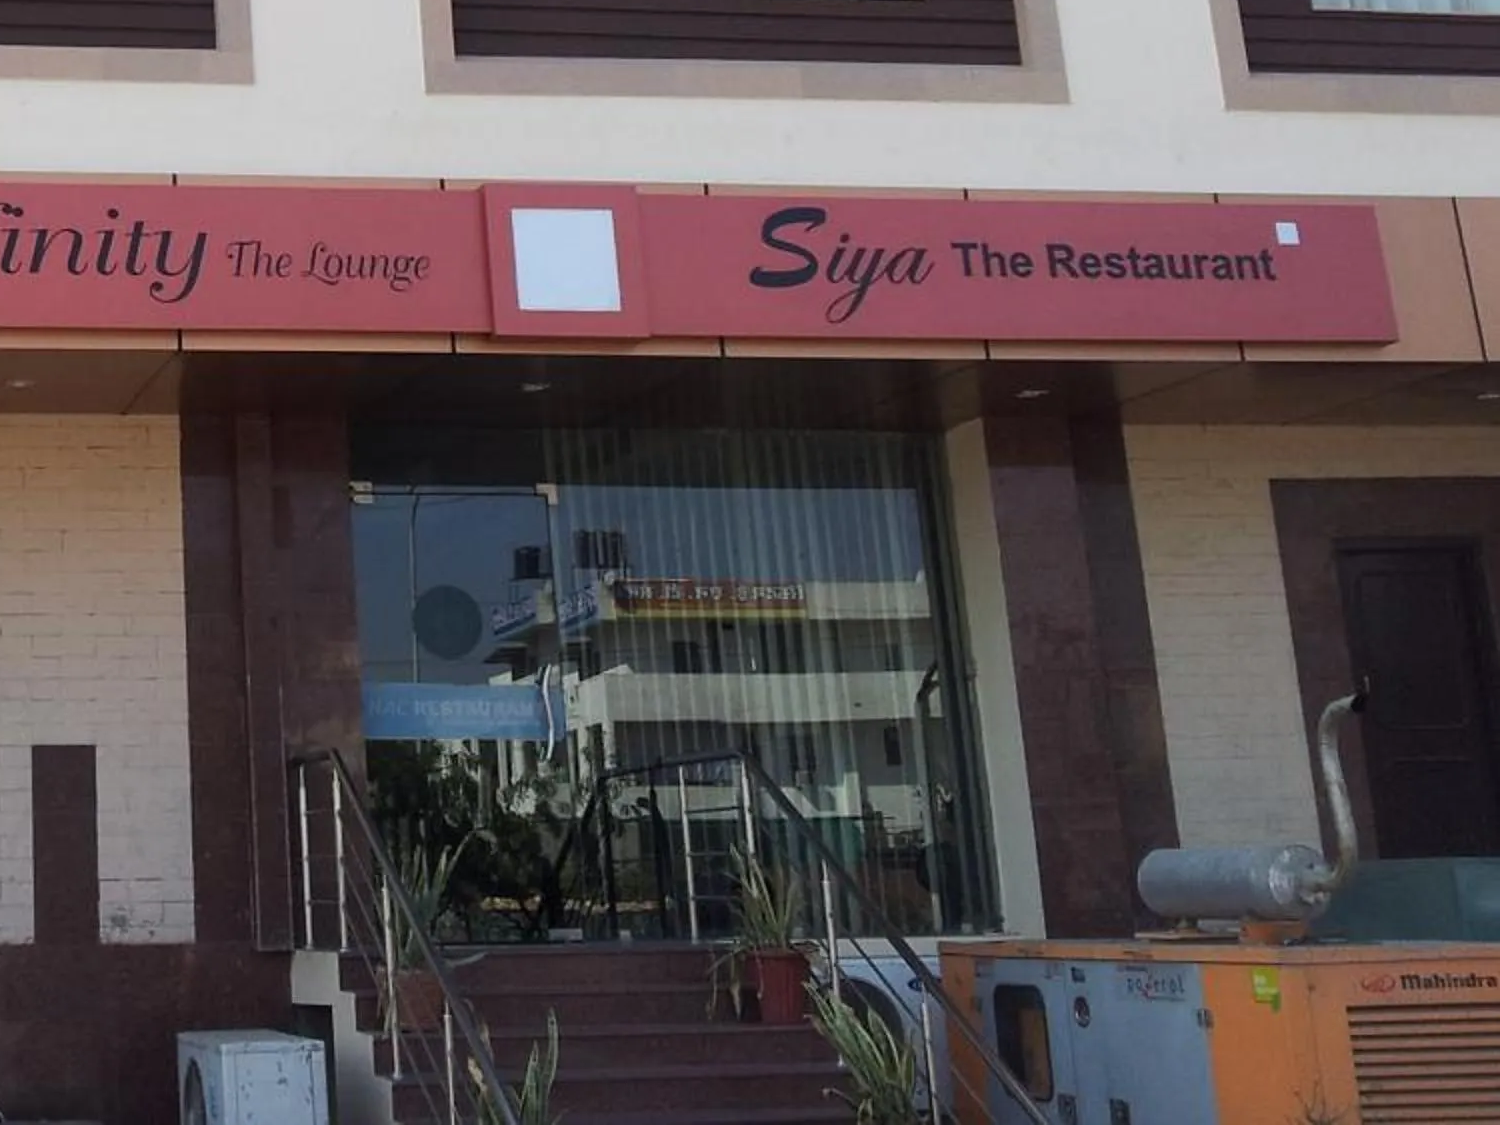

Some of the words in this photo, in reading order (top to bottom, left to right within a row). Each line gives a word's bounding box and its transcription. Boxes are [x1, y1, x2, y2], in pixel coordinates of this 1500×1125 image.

[226, 240, 294, 279] The
[299, 241, 432, 292] Lounge
[749, 206, 935, 324] Siya
[950, 241, 1034, 279] The
[1044, 243, 1278, 282] Restaurant
[1399, 973, 1498, 990] Mahindra
